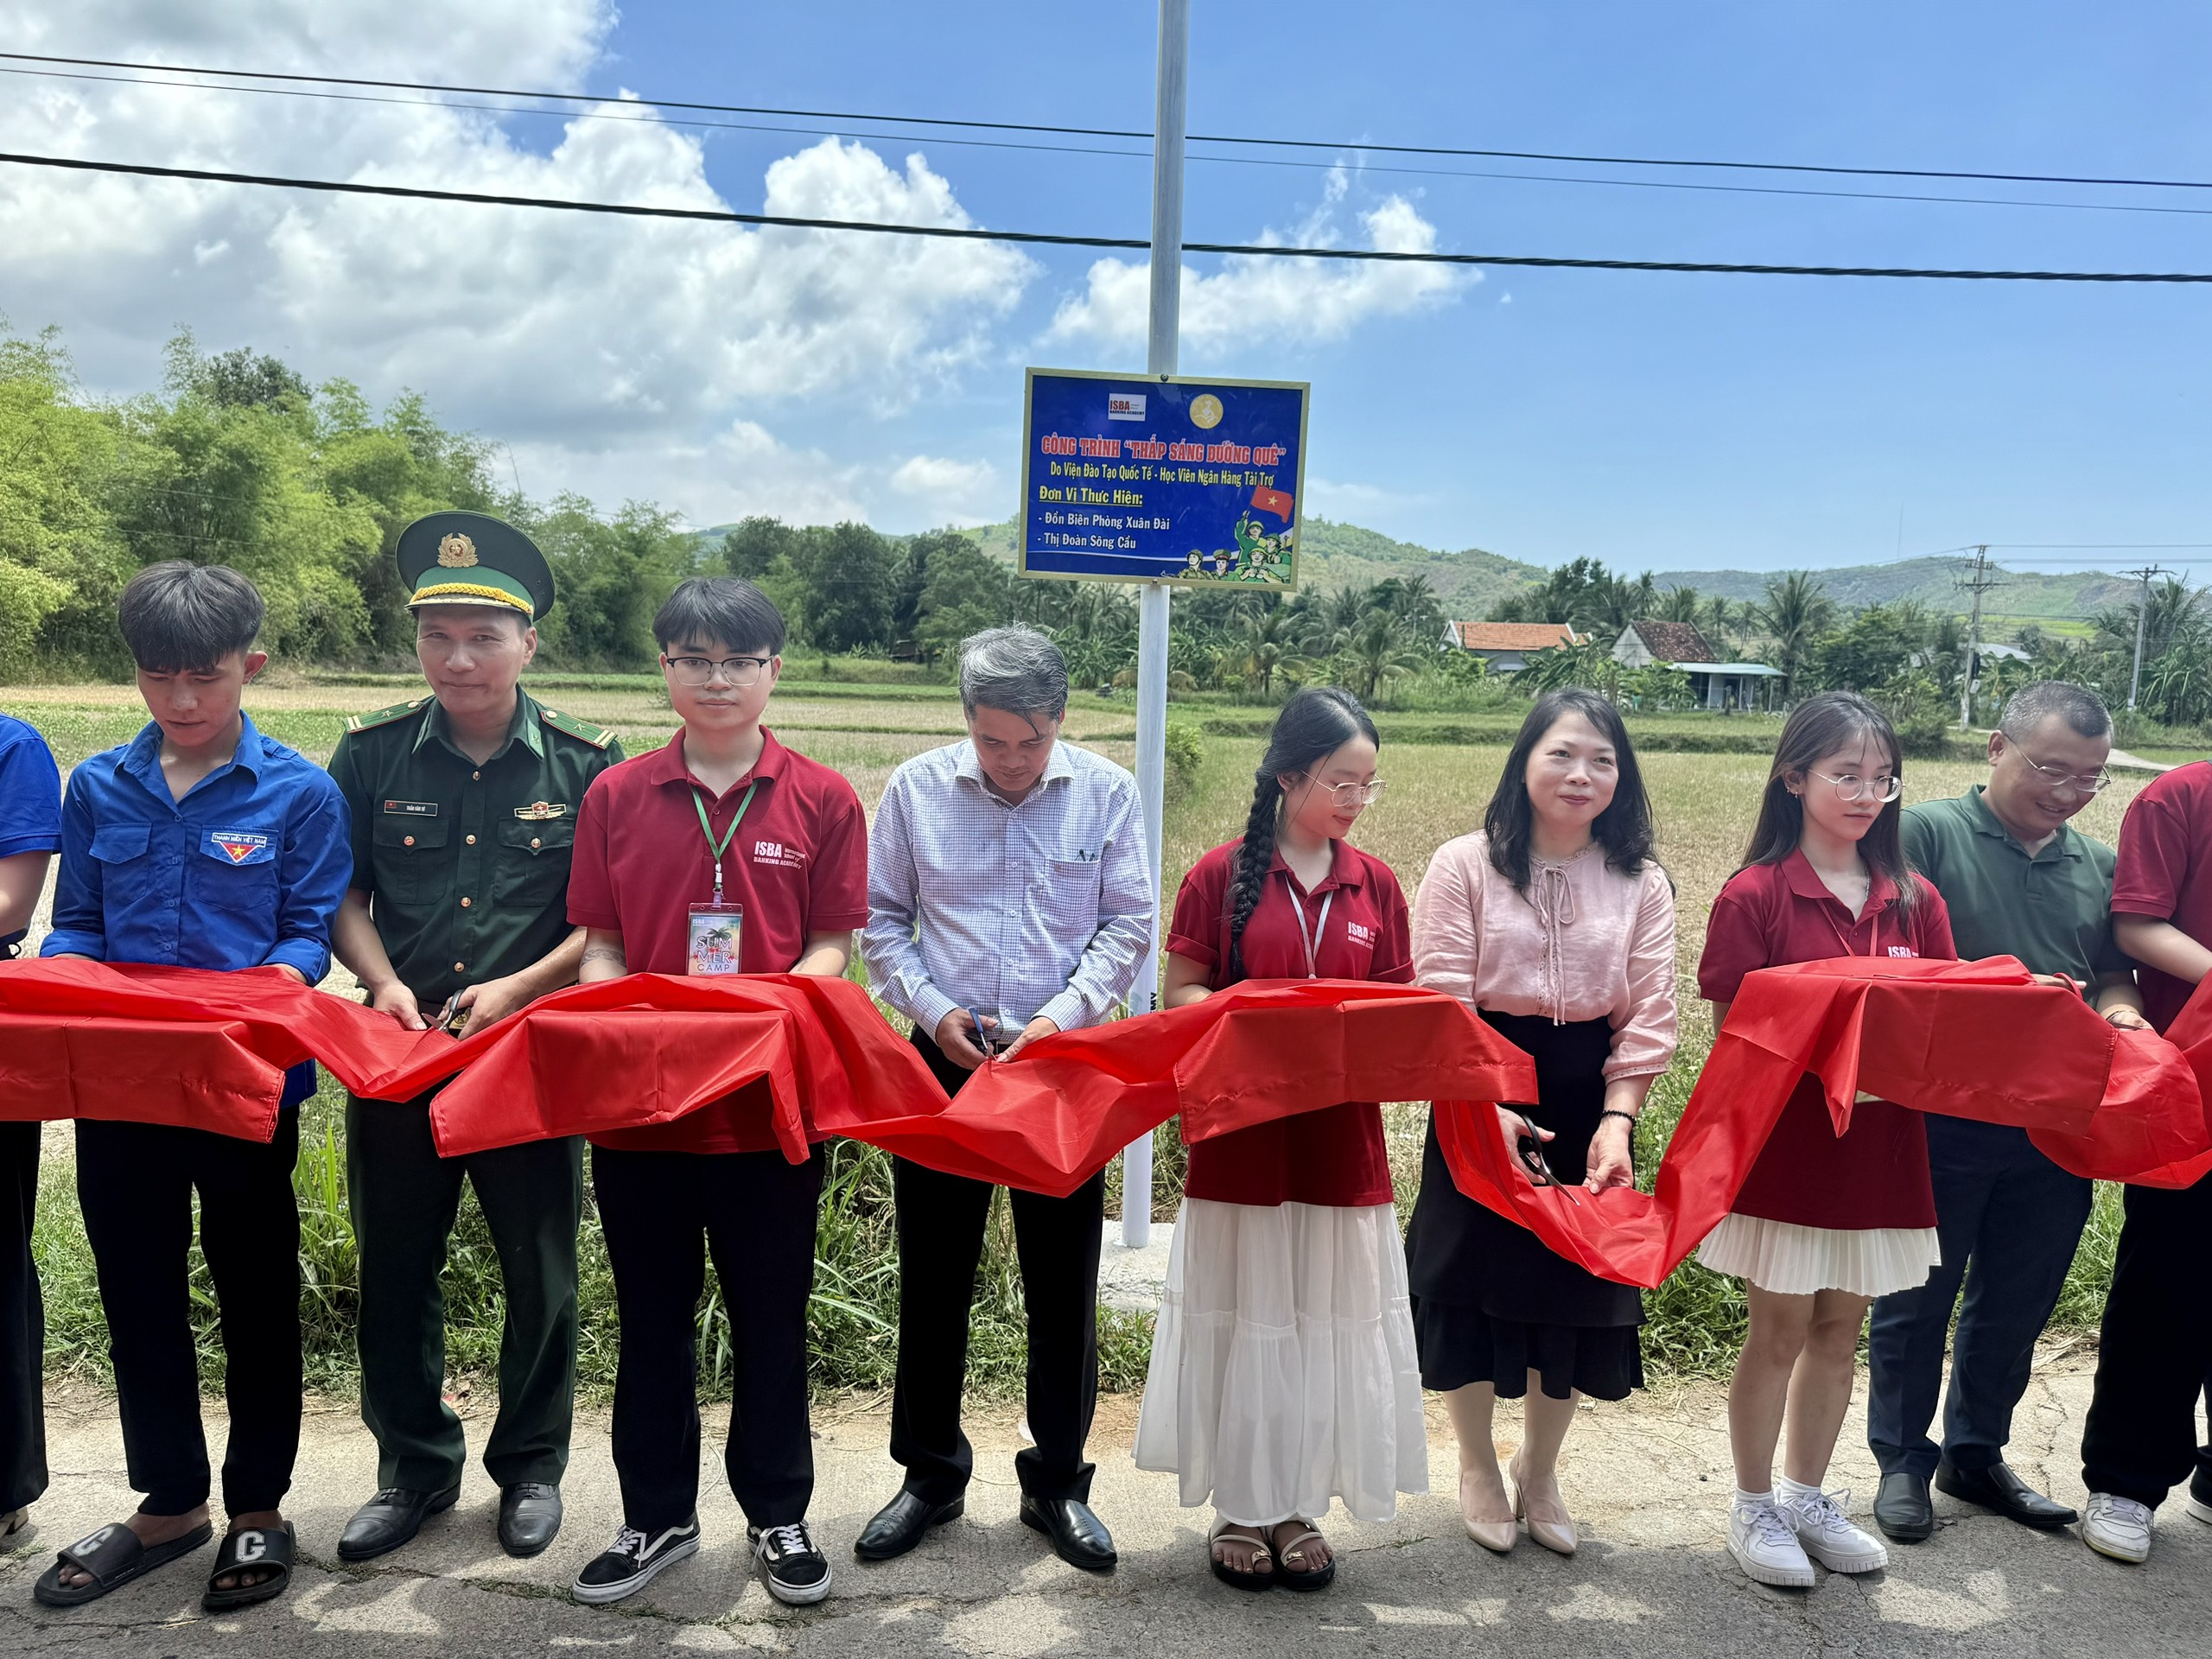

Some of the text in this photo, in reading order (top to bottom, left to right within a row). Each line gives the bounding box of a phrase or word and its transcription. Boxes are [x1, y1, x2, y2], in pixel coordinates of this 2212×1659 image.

[1109, 400, 1130, 410] ISBA
[1041, 432, 1077, 456] CÔNG
[1079, 434, 1121, 458] TRÌNH
[1169, 438, 1204, 462] SÁNG
[1051, 461, 1062, 476] Do
[1064, 462, 1081, 480] Viện
[1084, 463, 1100, 478] Đào
[1102, 464, 1117, 481] Tạo
[1119, 464, 1139, 482] Quốc
[1141, 465, 1154, 480] Tế
[1160, 467, 1176, 484] Học
[1198, 469, 1219, 486] Ngân
[1221, 470, 1242, 487] Hàng
[1244, 471, 1257, 486] Tài
[1259, 472, 1274, 489] Trợ
[1039, 485, 1062, 501] Đơn
[1066, 487, 1077, 504] Vị
[1045, 511, 1064, 524] Đồn
[1068, 513, 1089, 526] Biên
[1093, 514, 1123, 530] Phòng
[1126, 516, 1150, 529] Xuân
[1154, 518, 1170, 530] Đài
[1044, 532, 1059, 547] Thị
[1062, 533, 1087, 546] Đoàn
[1090, 534, 1115, 550] Sông
[1117, 535, 1136, 549] Cầu
[754, 841, 782, 858] ISBA
[780, 860, 802, 870] ACADEMY
[1348, 921, 1369, 940] ISBA
[696, 936, 732, 949] SUM
[697, 950, 732, 963] MER
[72, 1526, 115, 1557] G
[235, 1530, 267, 1562] G
